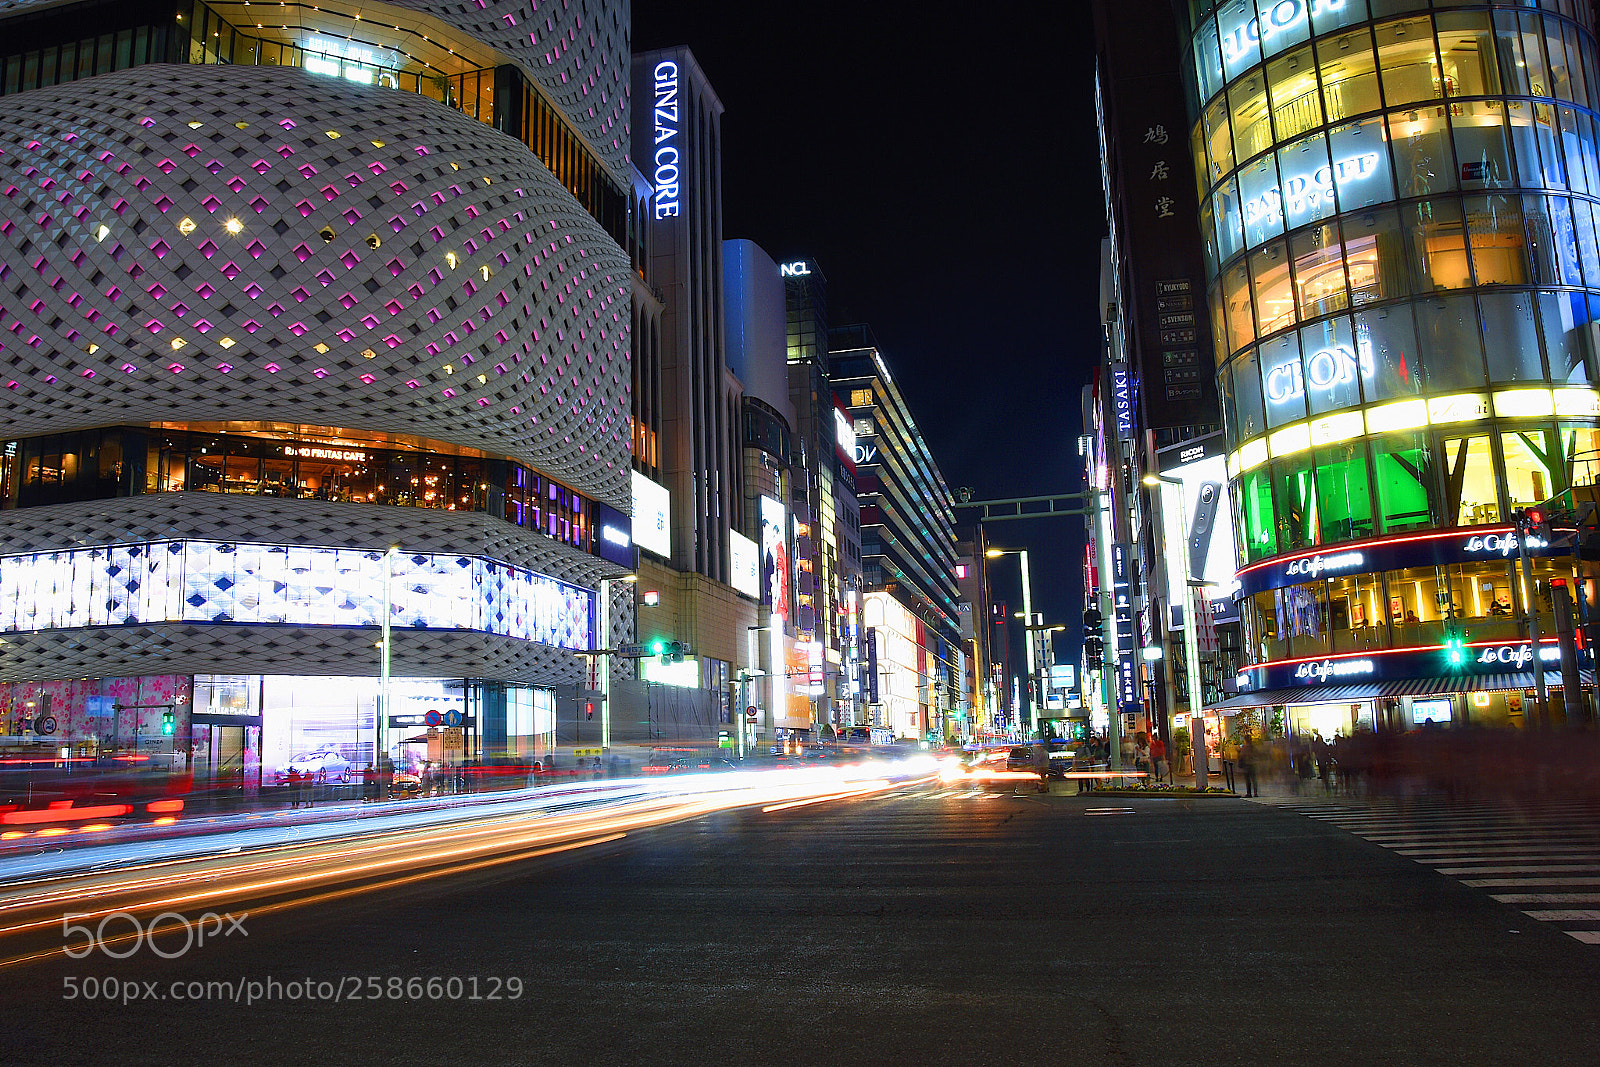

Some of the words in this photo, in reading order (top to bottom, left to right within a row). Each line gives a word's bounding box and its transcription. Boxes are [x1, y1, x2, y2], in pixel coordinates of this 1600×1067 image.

[653, 61, 679, 144] GINZA
[1142, 124, 1176, 219] 鳩居堂
[1314, 153, 1376, 187] OFF
[654, 147, 680, 220] CORE
[780, 261, 811, 277] NCL
[1114, 370, 1131, 432] TASAKI
[311, 448, 343, 460] FRUTAS
[343, 451, 366, 462] CAFE
[1180, 445, 1204, 459] RICOH
[1483, 532, 1519, 557] Café
[1299, 555, 1324, 579] Café
[1497, 644, 1533, 669] Café
[1308, 659, 1333, 683] Café
